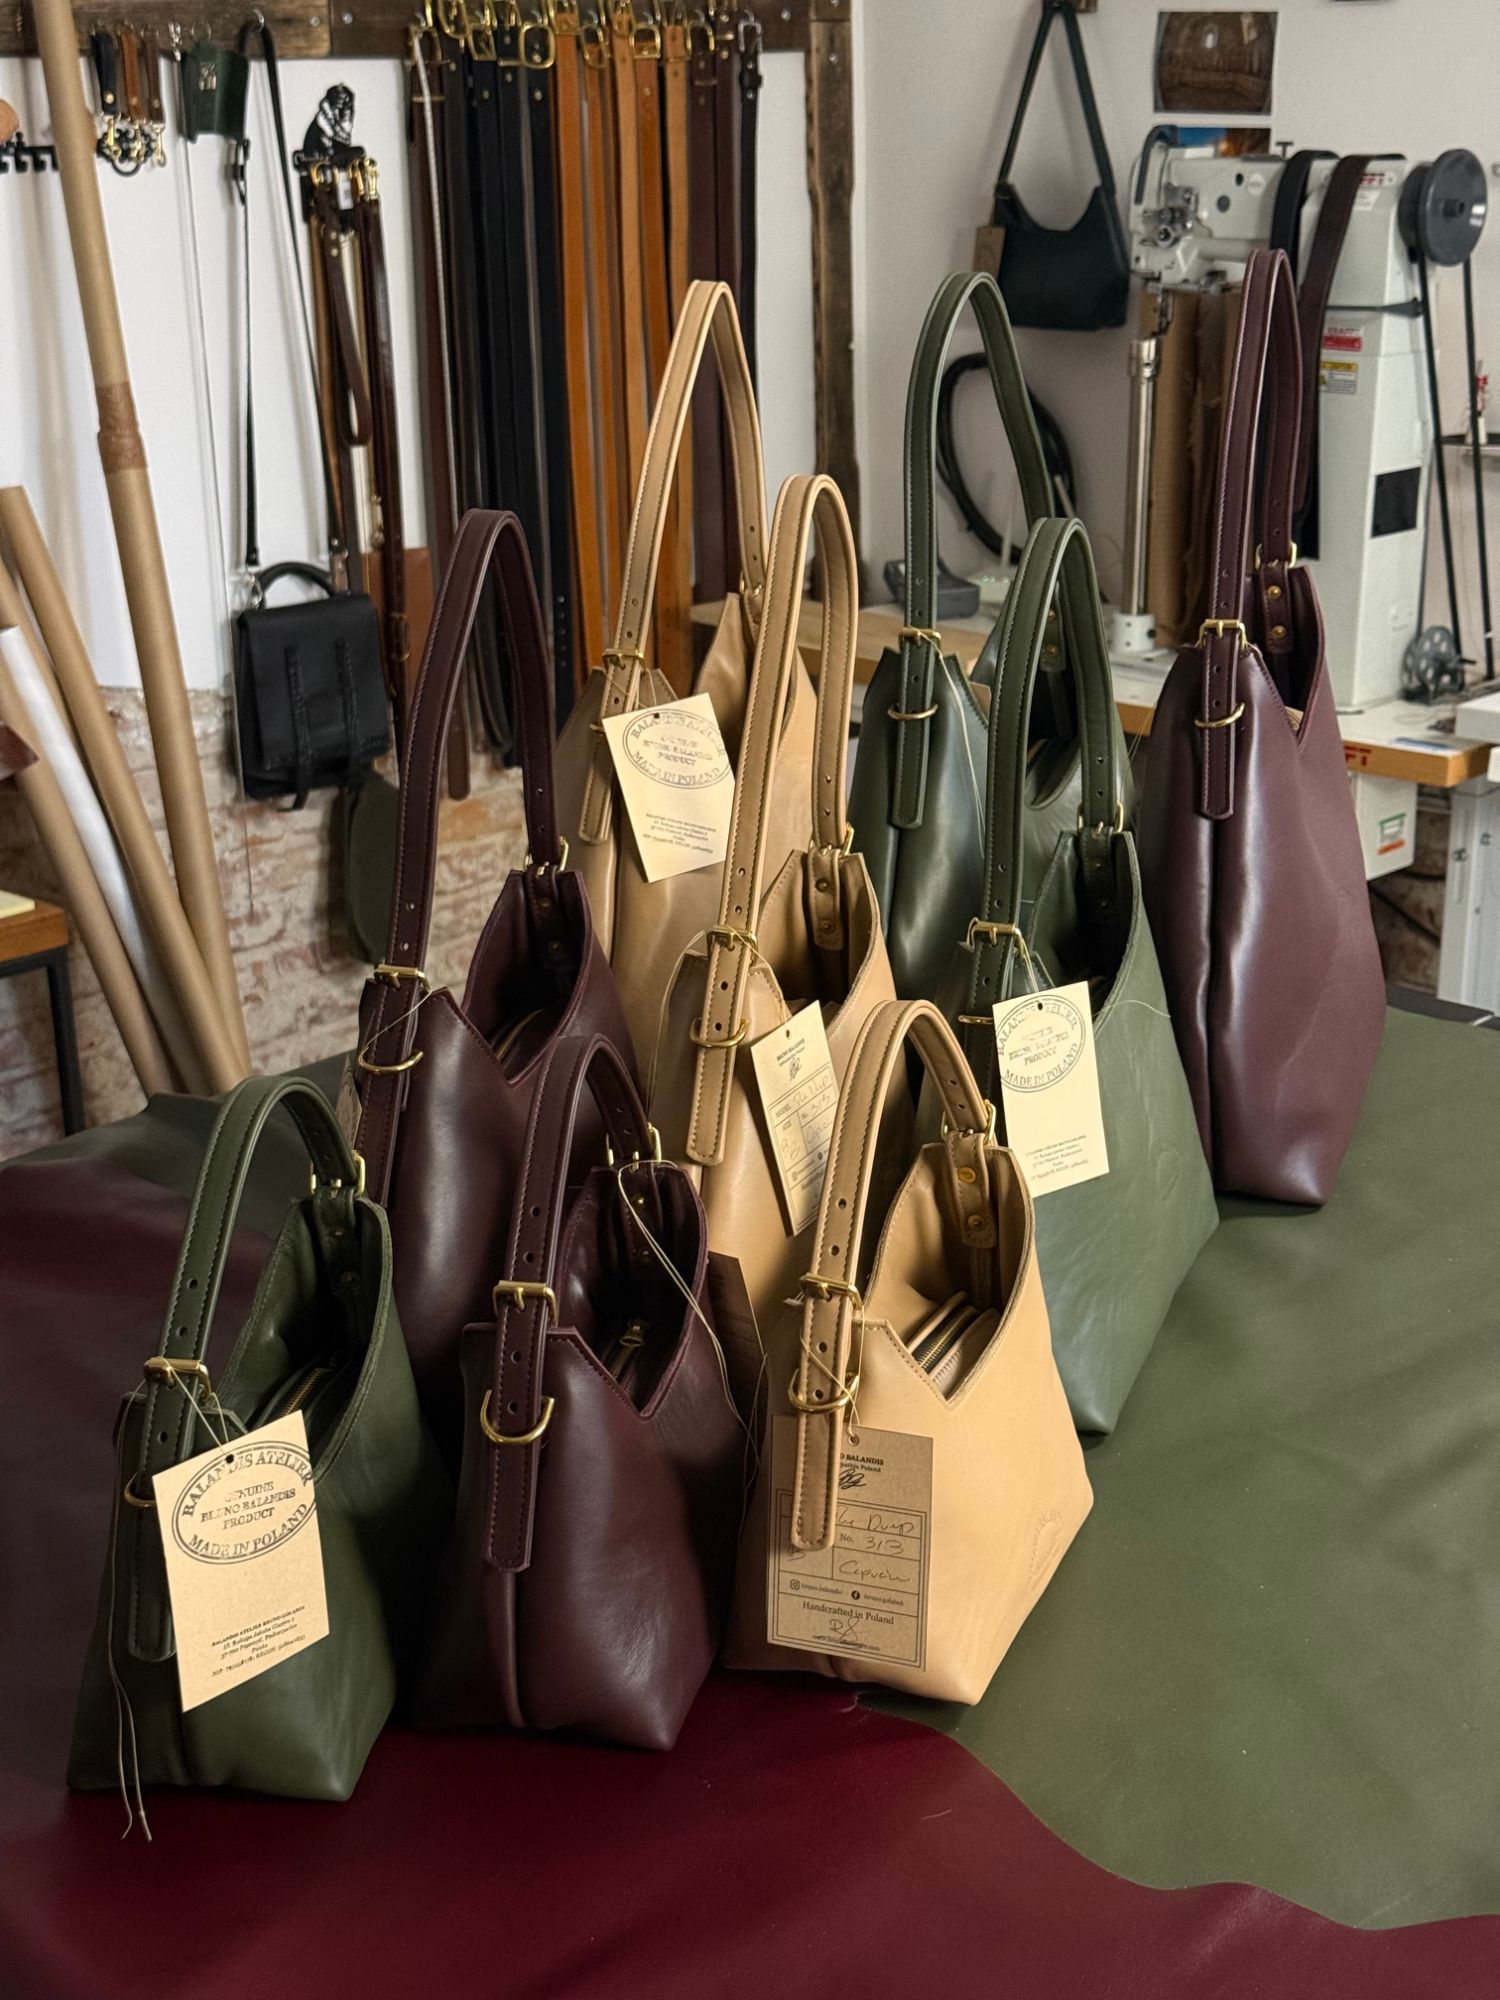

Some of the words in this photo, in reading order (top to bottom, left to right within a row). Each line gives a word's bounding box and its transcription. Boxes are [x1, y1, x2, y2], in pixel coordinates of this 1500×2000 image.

[1046, 1042, 1078, 1081] POLAND
[255, 1450, 313, 1487] ATELIER
[846, 1454, 884, 1466] BALANDIS
[188, 1534, 231, 1556] MADE
[233, 1541, 251, 1556] IN
[252, 1503, 308, 1551] POLAND
[223, 1507, 275, 1530] PRODUCT
[802, 1600, 853, 1617] Handcrafted
[854, 1610, 863, 1619] in
[865, 1611, 894, 1625] Poland
